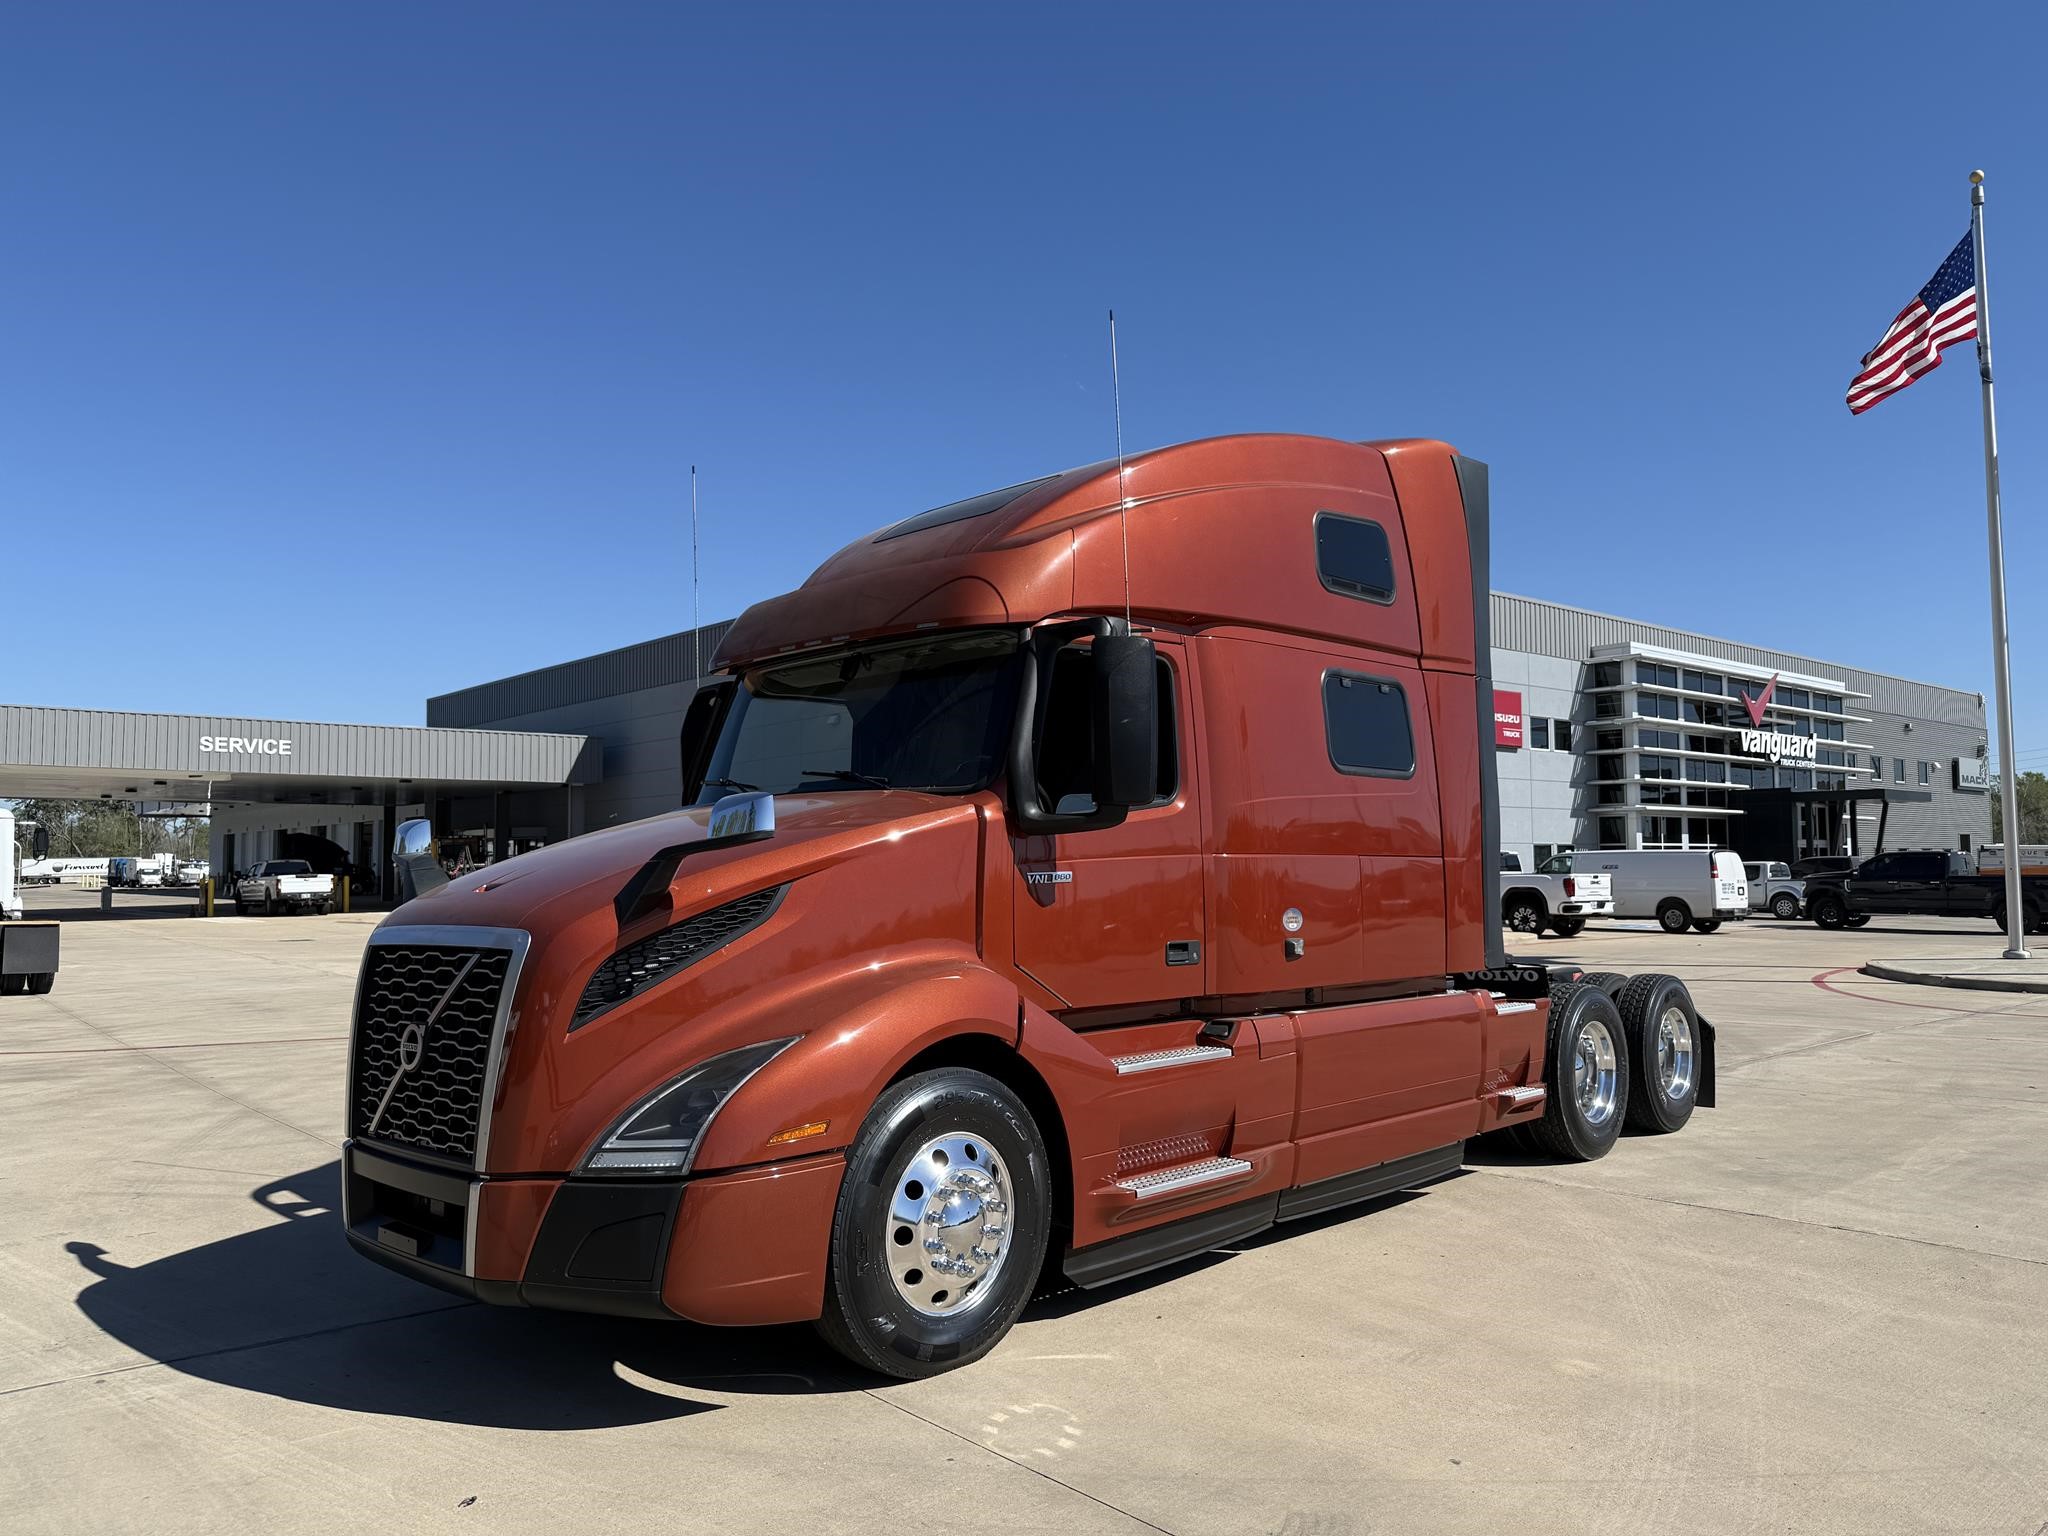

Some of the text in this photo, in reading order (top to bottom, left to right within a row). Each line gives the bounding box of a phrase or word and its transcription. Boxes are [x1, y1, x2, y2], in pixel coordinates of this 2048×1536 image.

[1494, 713, 1520, 724] ISUZU
[1502, 730, 1521, 738] TRUCK
[199, 735, 292, 755] SERVICE
[1780, 758, 1796, 767] TRUCK
[1961, 774, 1988, 786] MACK
[1027, 873, 1053, 884] VNL
[1463, 969, 1539, 982] VOLVO
